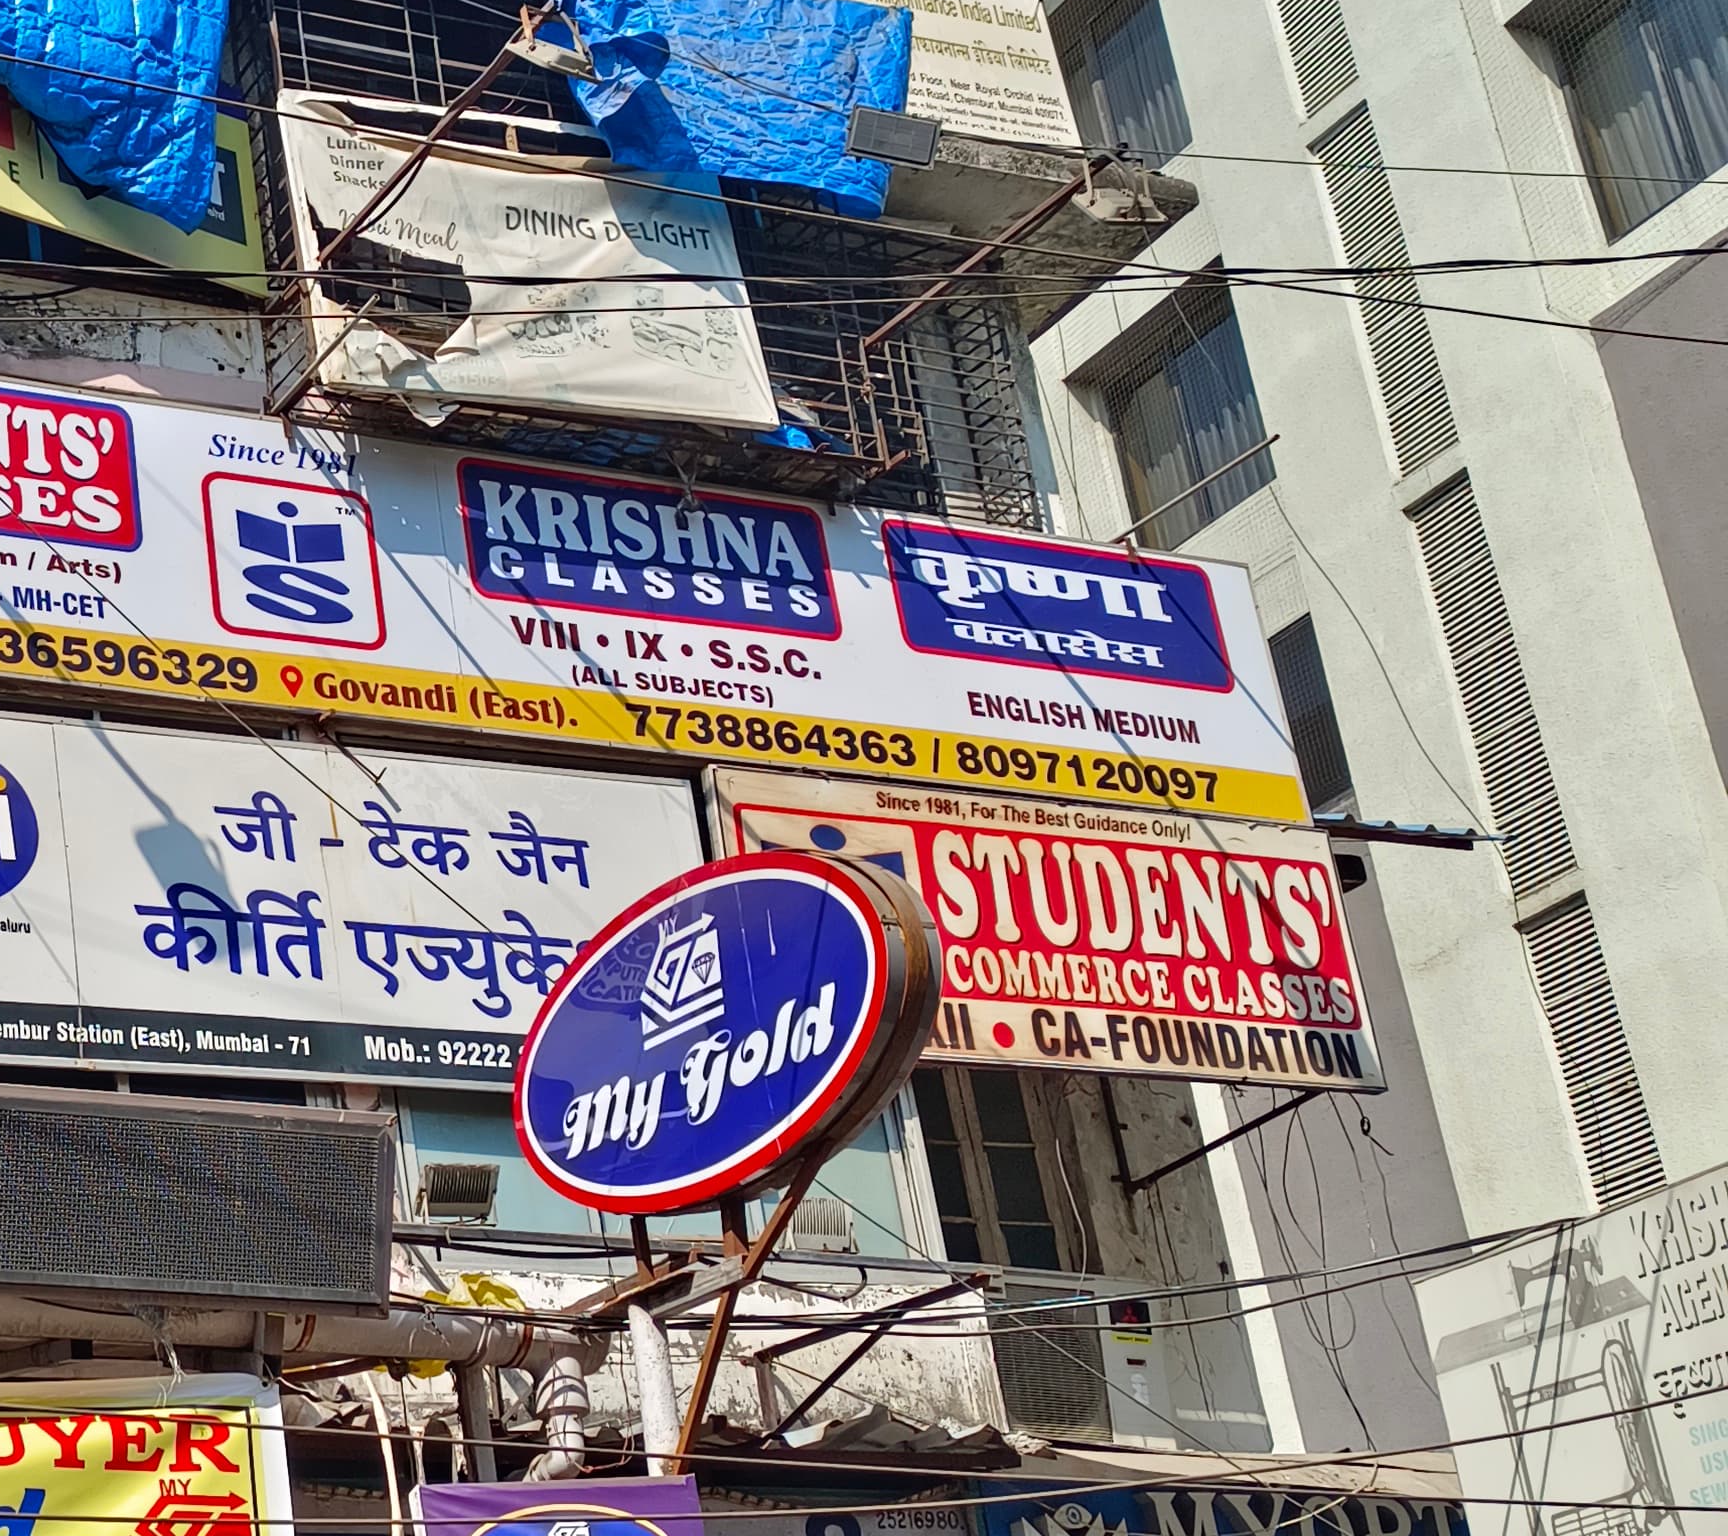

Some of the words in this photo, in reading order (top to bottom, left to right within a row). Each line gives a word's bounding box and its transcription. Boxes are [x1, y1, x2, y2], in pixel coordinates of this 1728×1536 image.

[993, 4, 1042, 33] Limited
[329, 154, 385, 172] Dinner
[333, 170, 388, 191] Snacks
[505, 205, 597, 243] DINING
[603, 218, 712, 254] DELIGHT
[208, 431, 286, 467] Since
[294, 445, 358, 478] 1981
[477, 478, 816, 583] KRISHNA
[45, 550, 123, 584] Arts)
[487, 544, 822, 619] CLASSES
[903, 543, 1174, 624] कृष्णा
[12, 583, 110, 620] MH-CET
[510, 614, 582, 654] VIII
[624, 628, 668, 663] IX
[709, 639, 823, 681] S.S.C.
[944, 616, 1166, 669] क्लासेस
[571, 664, 629, 691] (ALL
[634, 670, 775, 710] SUBJECTS)
[313, 671, 457, 714] Govandi
[468, 686, 579, 730] (East).
[625, 702, 917, 768] 7738864363
[956, 740, 1221, 804] 8097120097
[966, 691, 1086, 731] ENGLISH
[1092, 707, 1202, 745] MEDIUM
[212, 790, 299, 863] जी
[361, 800, 471, 876] टेक
[488, 811, 591, 889] जैन
[875, 789, 920, 814] Since
[925, 796, 966, 822] 1981,
[970, 801, 998, 824] For
[1001, 803, 1032, 826] The
[1035, 807, 1069, 830] Best
[1073, 811, 1148, 837] Guidance
[1151, 818, 1192, 844] Only!
[133, 882, 327, 981] कीर्ति
[343, 910, 590, 1019] एज्युके
[945, 944, 1174, 1009] COMMERCE
[1182, 964, 1356, 1026] CLASSES
[55, 1021, 126, 1047] Station
[129, 1026, 192, 1054] (East),
[195, 1030, 269, 1055] Mumbai
[286, 1035, 312, 1057] 71
[437, 1040, 513, 1068] 92222
[1030, 1007, 1364, 1080] CA-FOUNDATION
[562, 1070, 665, 1161] My
[679, 982, 836, 1127] Gold
